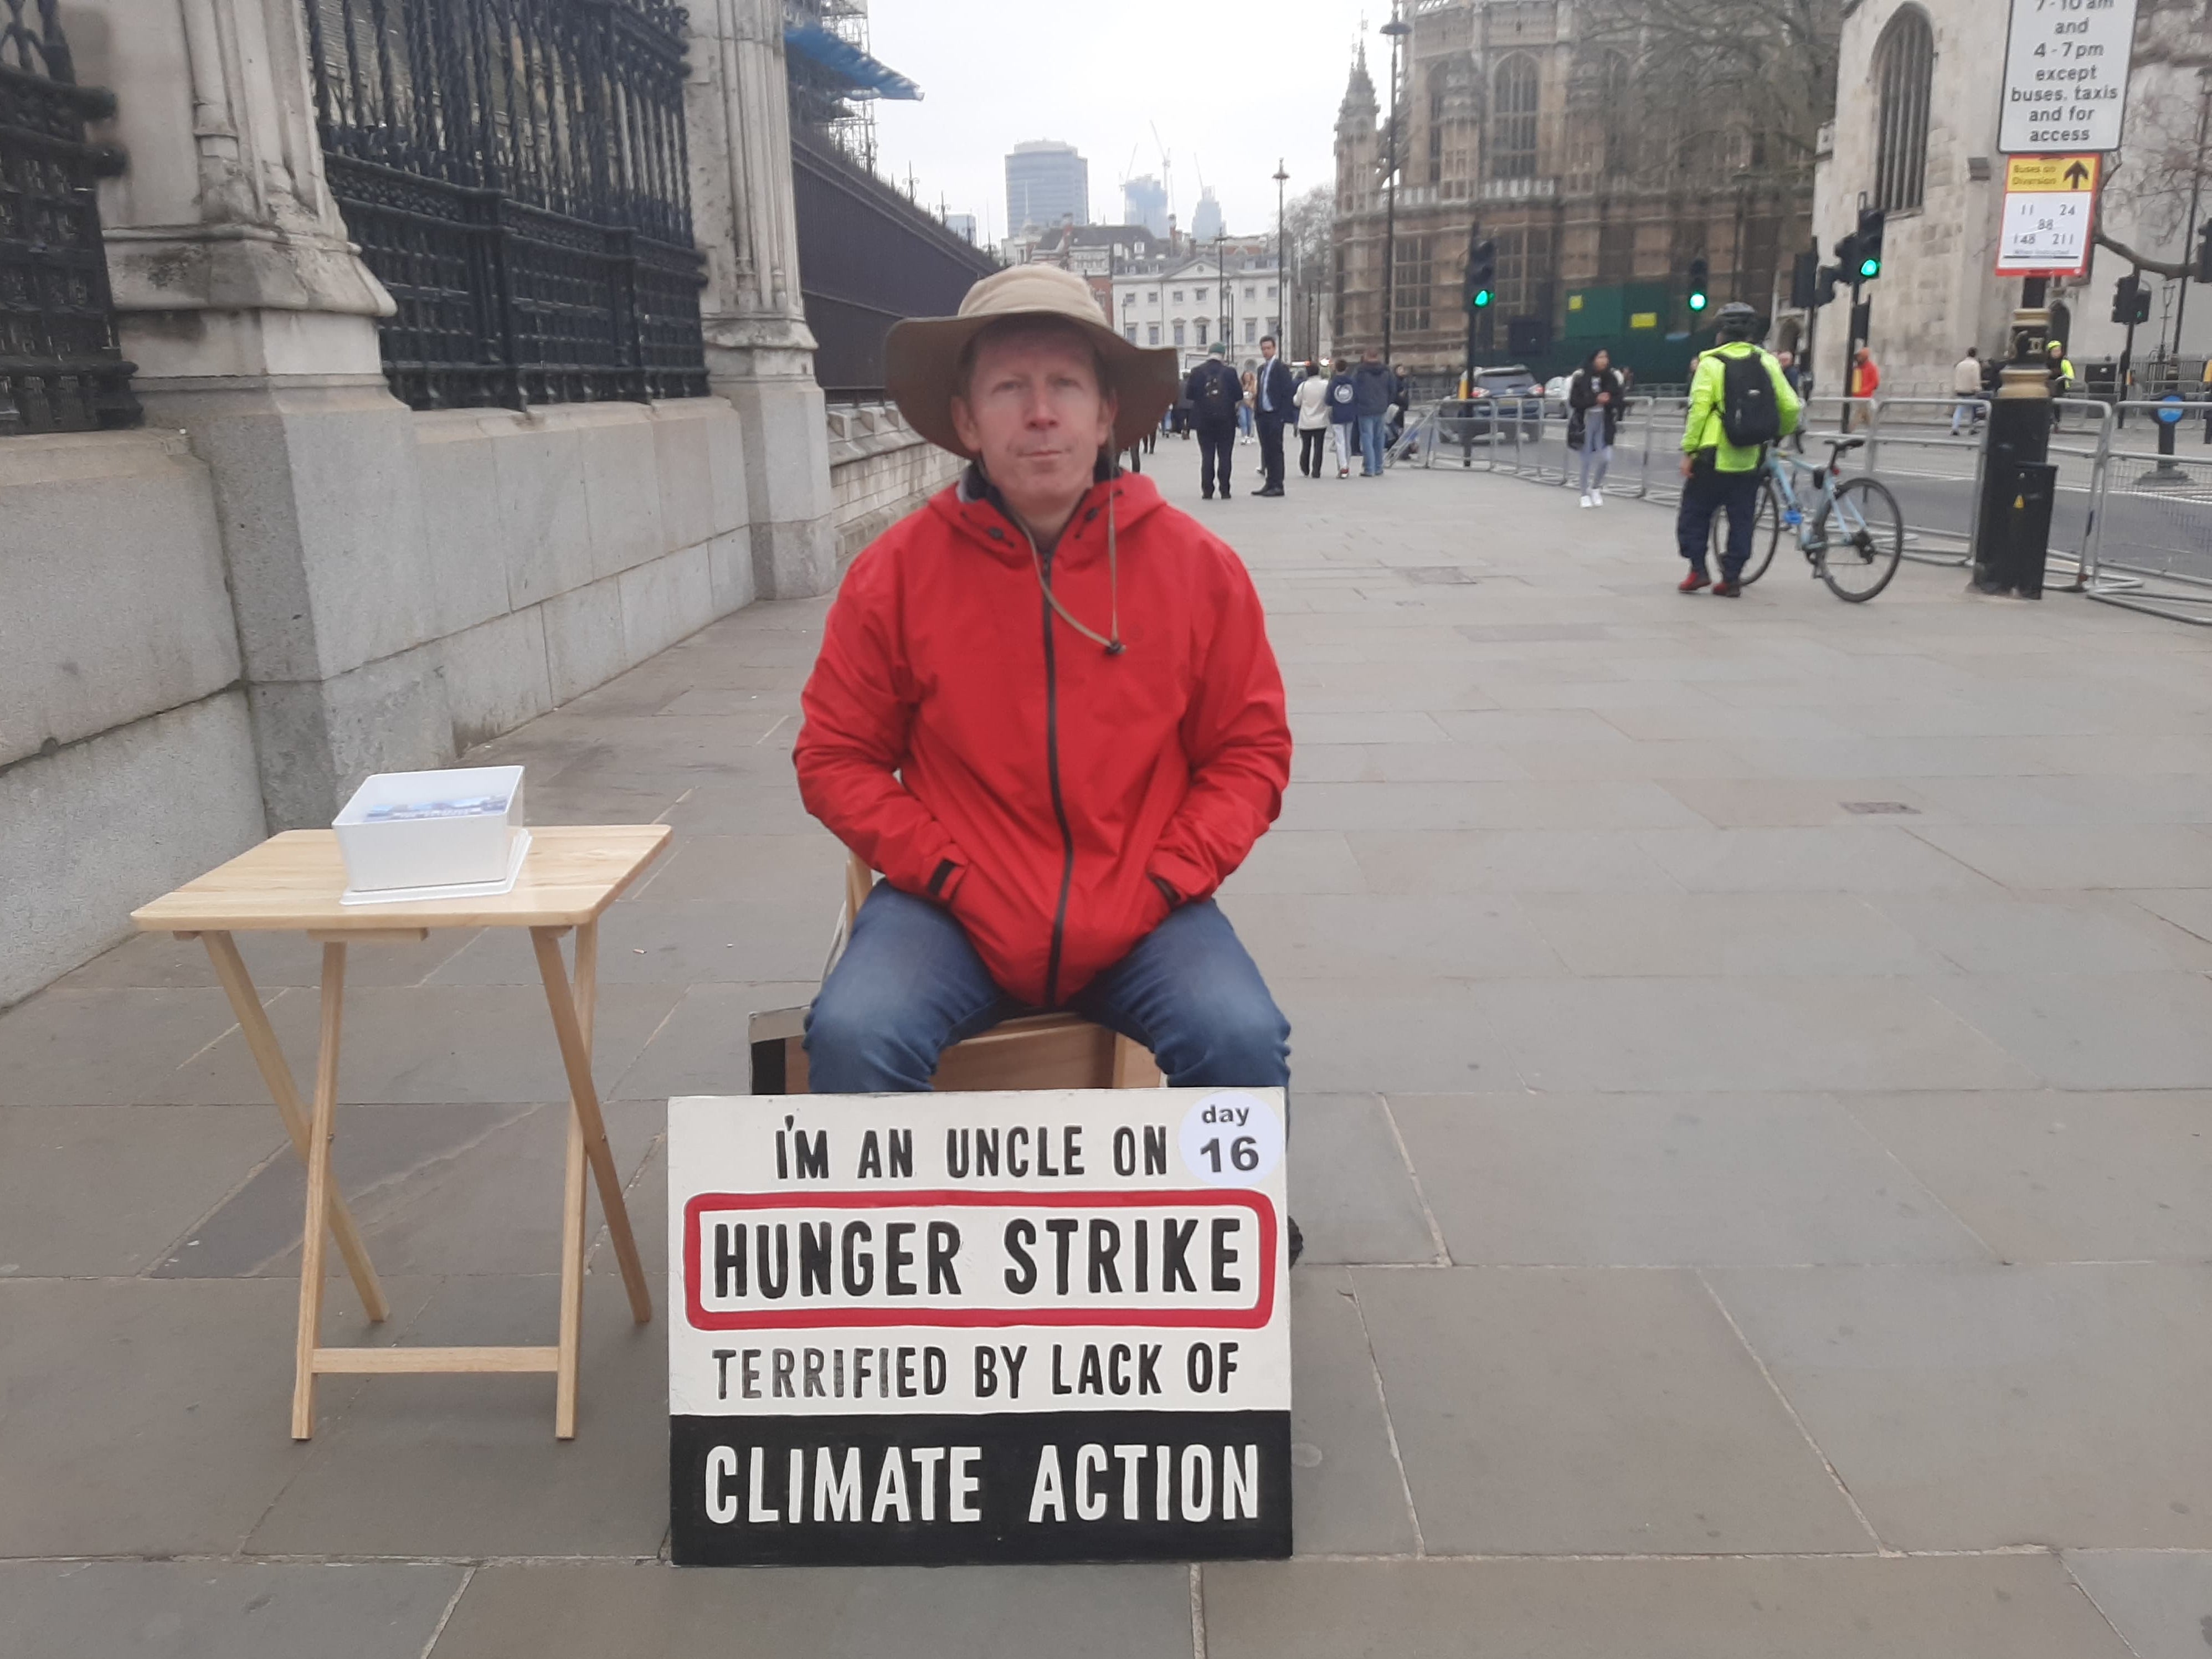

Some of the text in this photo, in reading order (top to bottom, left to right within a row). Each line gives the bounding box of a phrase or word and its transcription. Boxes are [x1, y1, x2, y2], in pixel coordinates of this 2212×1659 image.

[2055, 17, 2090, 34] and
[2036, 65, 2097, 83] except
[2075, 85, 2118, 100] taxis
[2029, 105, 2095, 121] and for
[2029, 129, 2090, 142] access
[2021, 204, 2075, 215] 11 24
[2052, 233, 2074, 244] 211
[1201, 1105, 1250, 1127] day
[775, 1114, 1167, 1180] I'M AN UNCLE ON
[1200, 1136, 1260, 1173] 16
[714, 1218, 1242, 1300] HUNGER STRIKE
[711, 1342, 1239, 1400] TERRIFIED BY LACK OF
[704, 1443, 1259, 1524] CLIMATE ACTION
